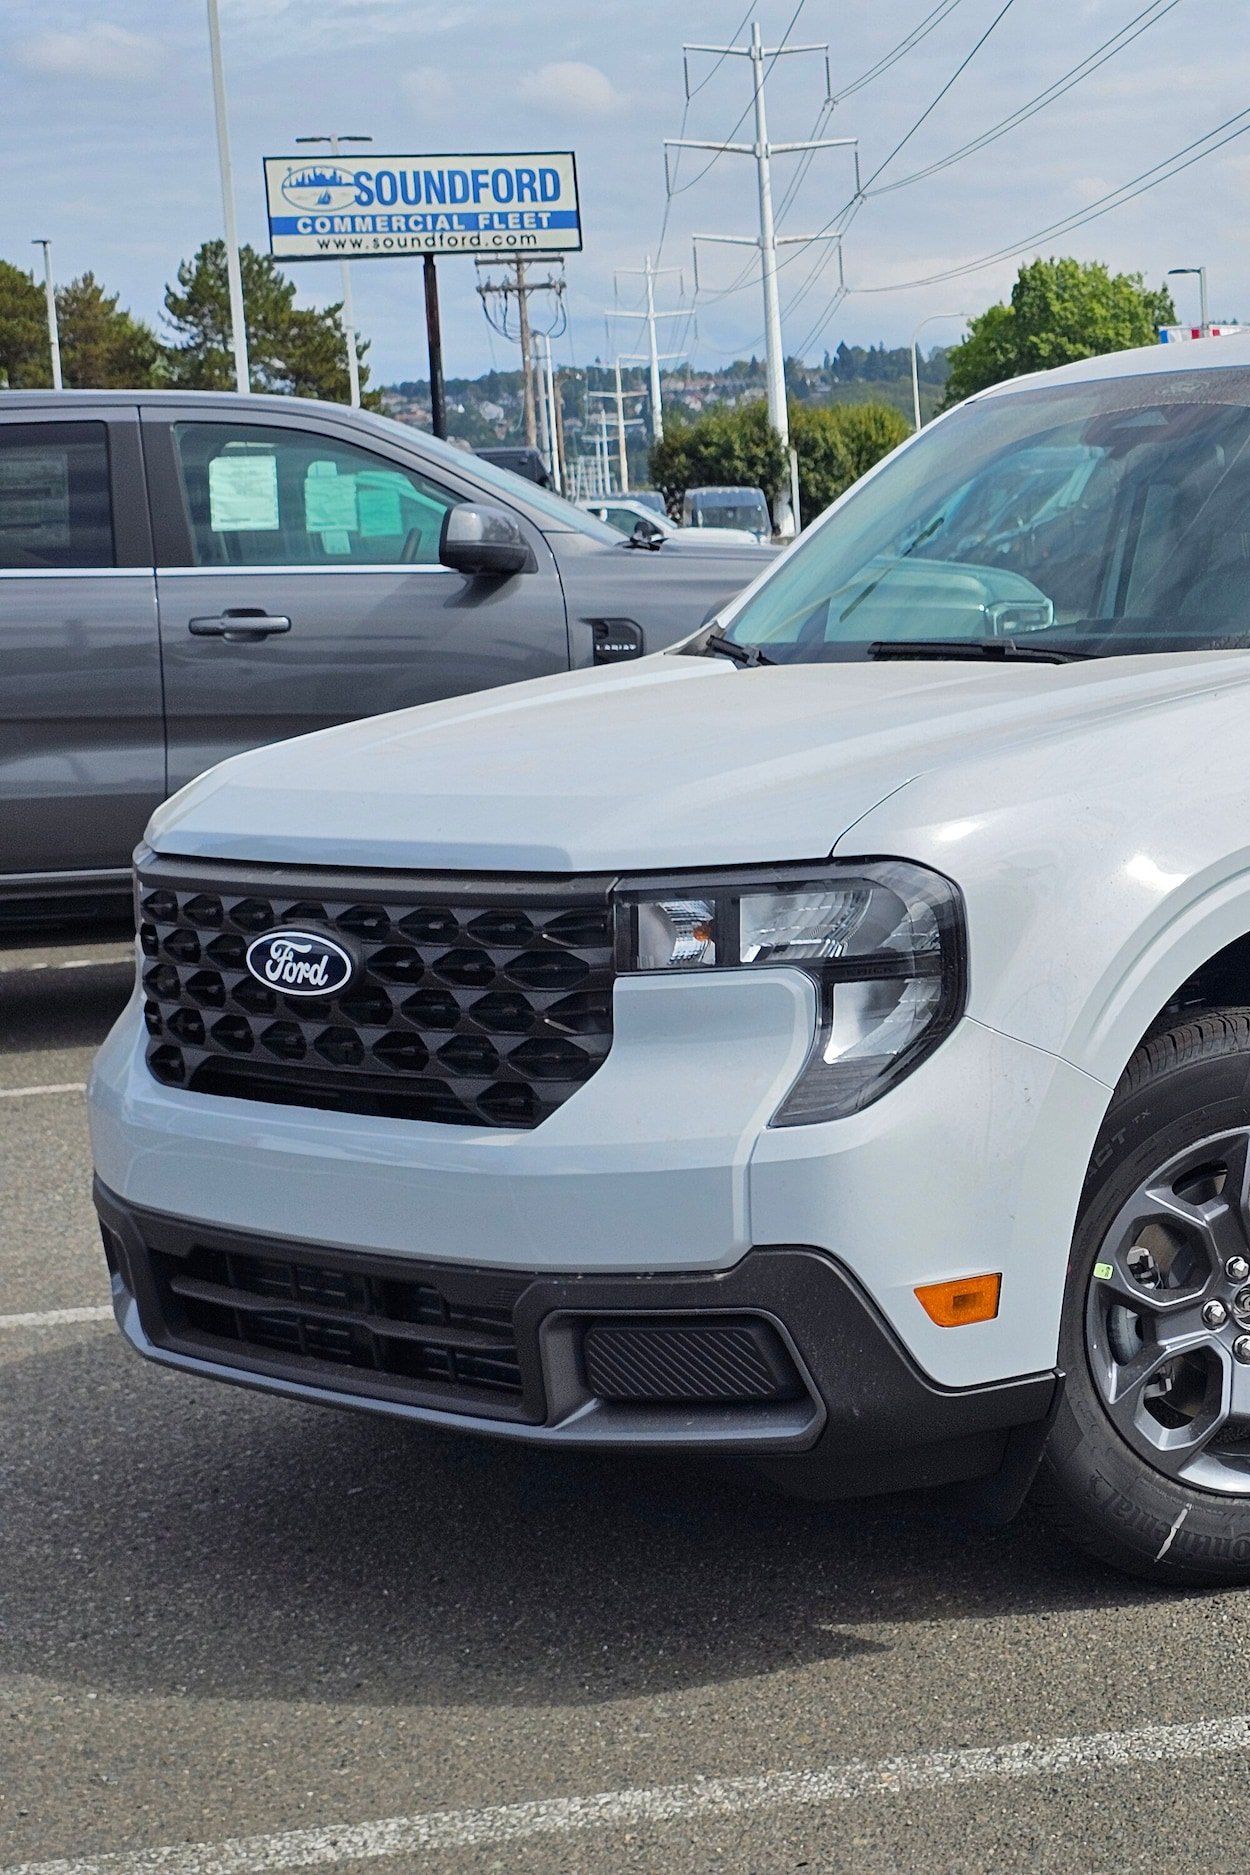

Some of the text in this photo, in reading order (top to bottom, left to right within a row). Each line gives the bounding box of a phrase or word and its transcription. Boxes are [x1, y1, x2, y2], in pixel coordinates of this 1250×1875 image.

[354, 167, 561, 207] SOUNDFORD
[296, 212, 552, 235] COMMERCIAL FLEET
[317, 232, 538, 250] www.soundford.com
[265, 939, 330, 986] Ford
